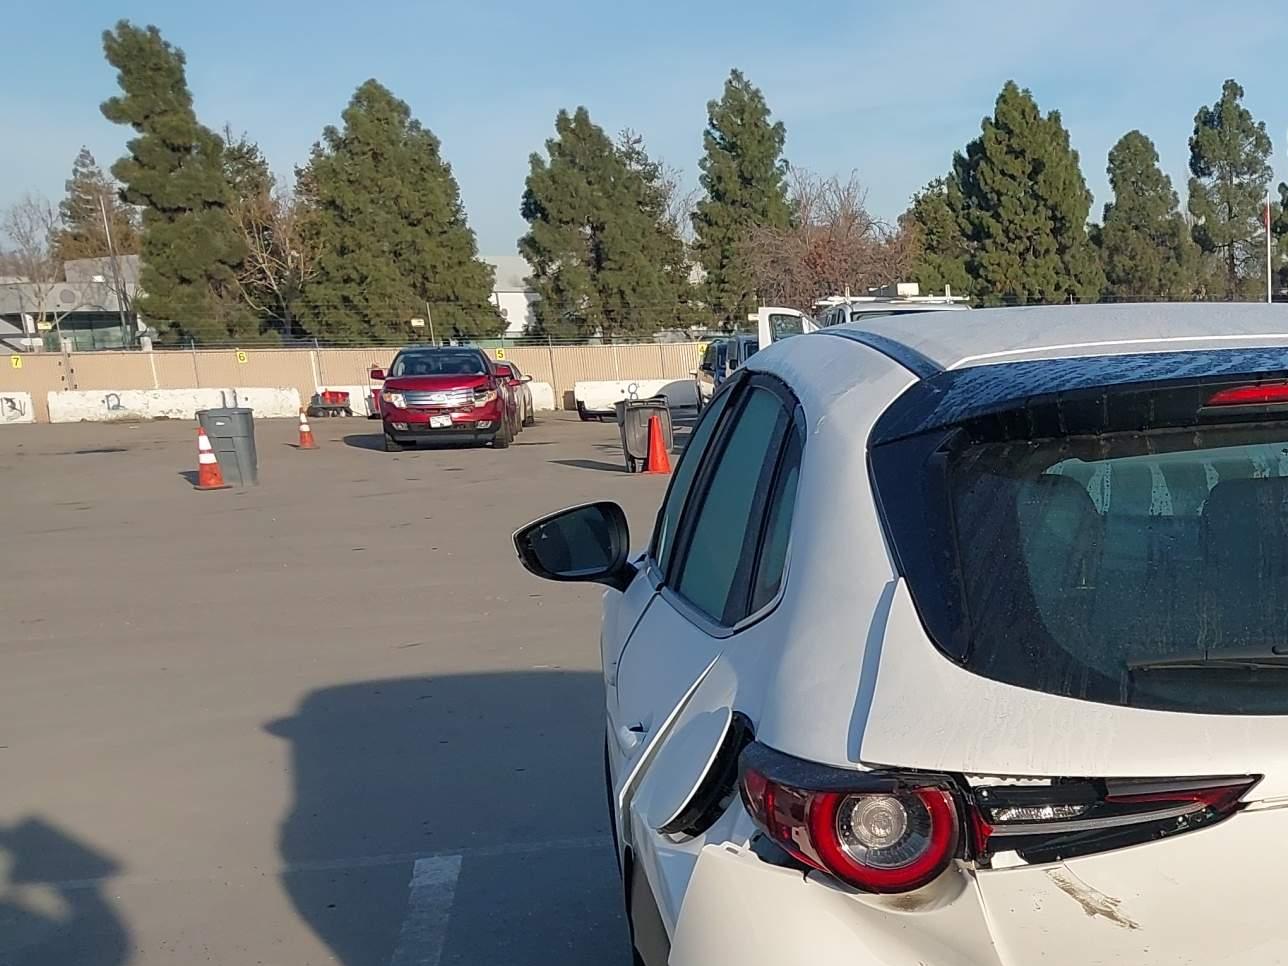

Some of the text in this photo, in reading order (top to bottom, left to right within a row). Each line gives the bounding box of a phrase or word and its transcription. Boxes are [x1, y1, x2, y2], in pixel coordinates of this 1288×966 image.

[238, 352, 246, 362] 6
[497, 351, 504, 359] 5
[12, 357, 20, 367] 7
